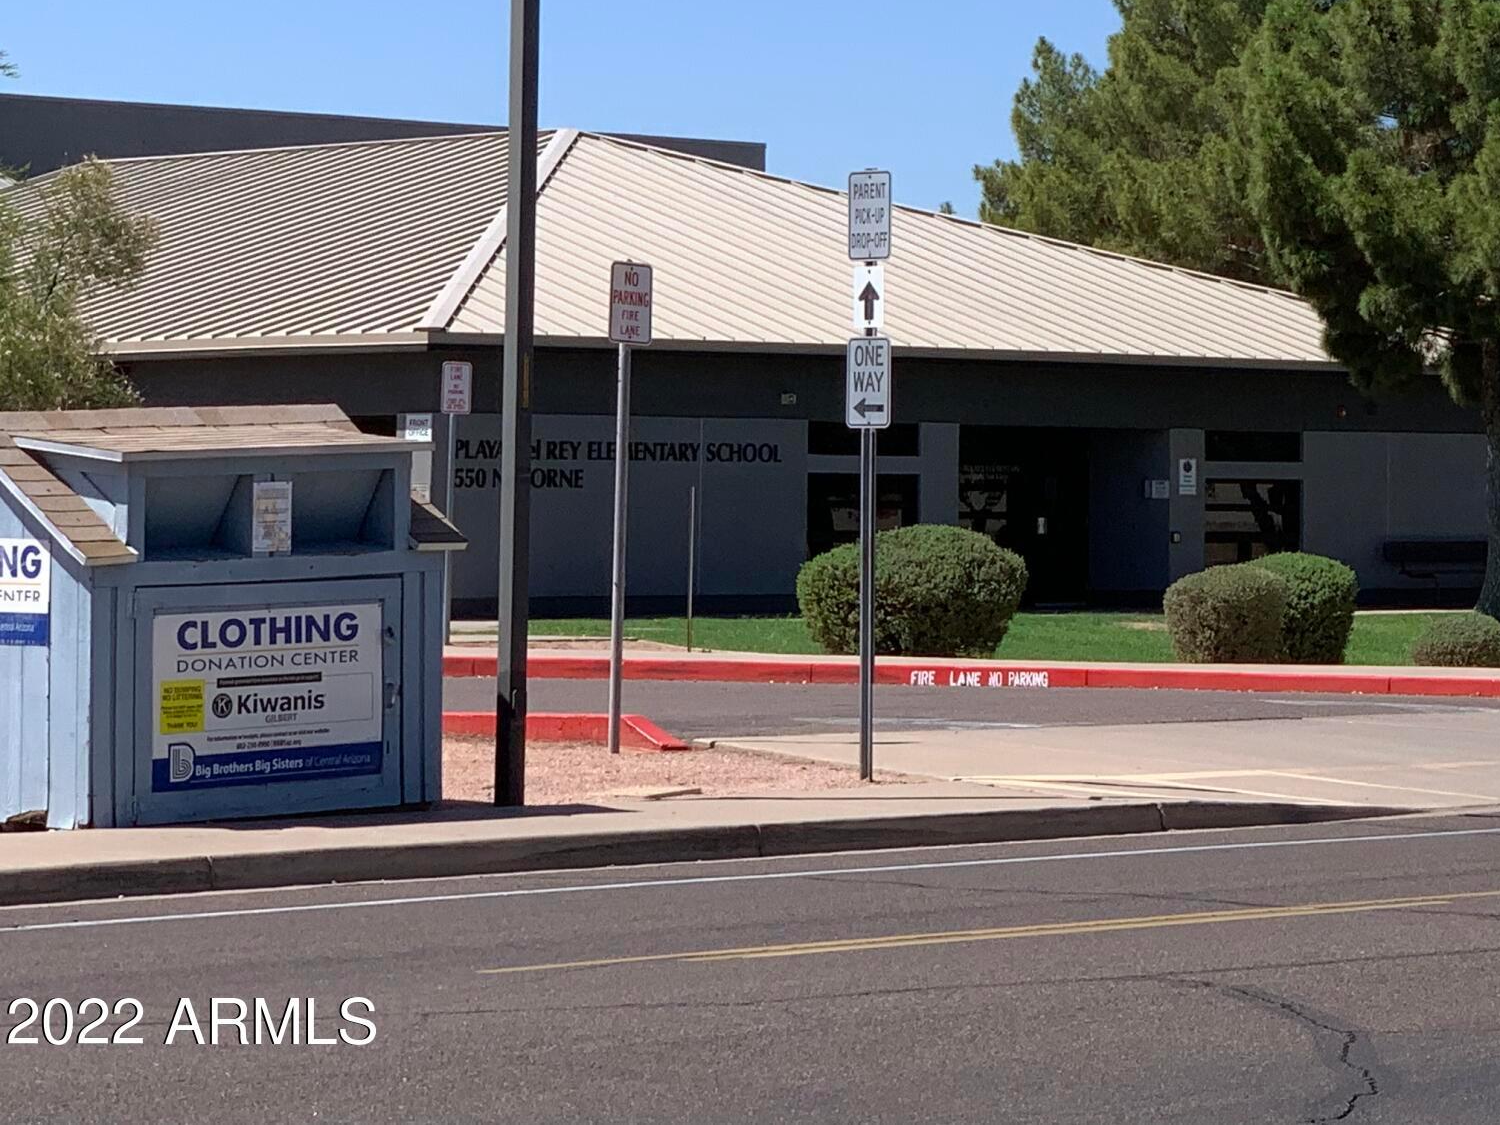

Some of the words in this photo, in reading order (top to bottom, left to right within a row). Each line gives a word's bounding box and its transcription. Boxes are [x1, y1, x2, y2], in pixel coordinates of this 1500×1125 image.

[853, 183, 886, 200] PARENT
[855, 207, 885, 224] PICK-UP
[851, 232, 888, 249] DROP-OFF
[624, 271, 639, 287] NO
[613, 290, 649, 307] PARKING
[621, 309, 640, 321] FIRE
[620, 325, 640, 336] LANE
[855, 345, 884, 367] ONE
[853, 371, 884, 393] WAY
[546, 440, 582, 460] REY
[706, 442, 782, 463] SCHOOL
[454, 467, 487, 488] 550
[528, 467, 584, 488] ORNE
[176, 612, 359, 651] CLOTHING
[177, 654, 284, 673] DONATION
[290, 650, 359, 667] CENTER
[910, 670, 936, 686] FIRE
[949, 670, 982, 686] LANE
[988, 672, 1003, 686] NO
[1008, 672, 1049, 686] PARKING
[237, 689, 325, 715] Kiwanis
[265, 713, 298, 723] GILBERT
[195, 764, 211, 778] Big
[212, 760, 253, 774] Brothers
[254, 758, 271, 772] Big
[272, 756, 304, 769] Sisters
